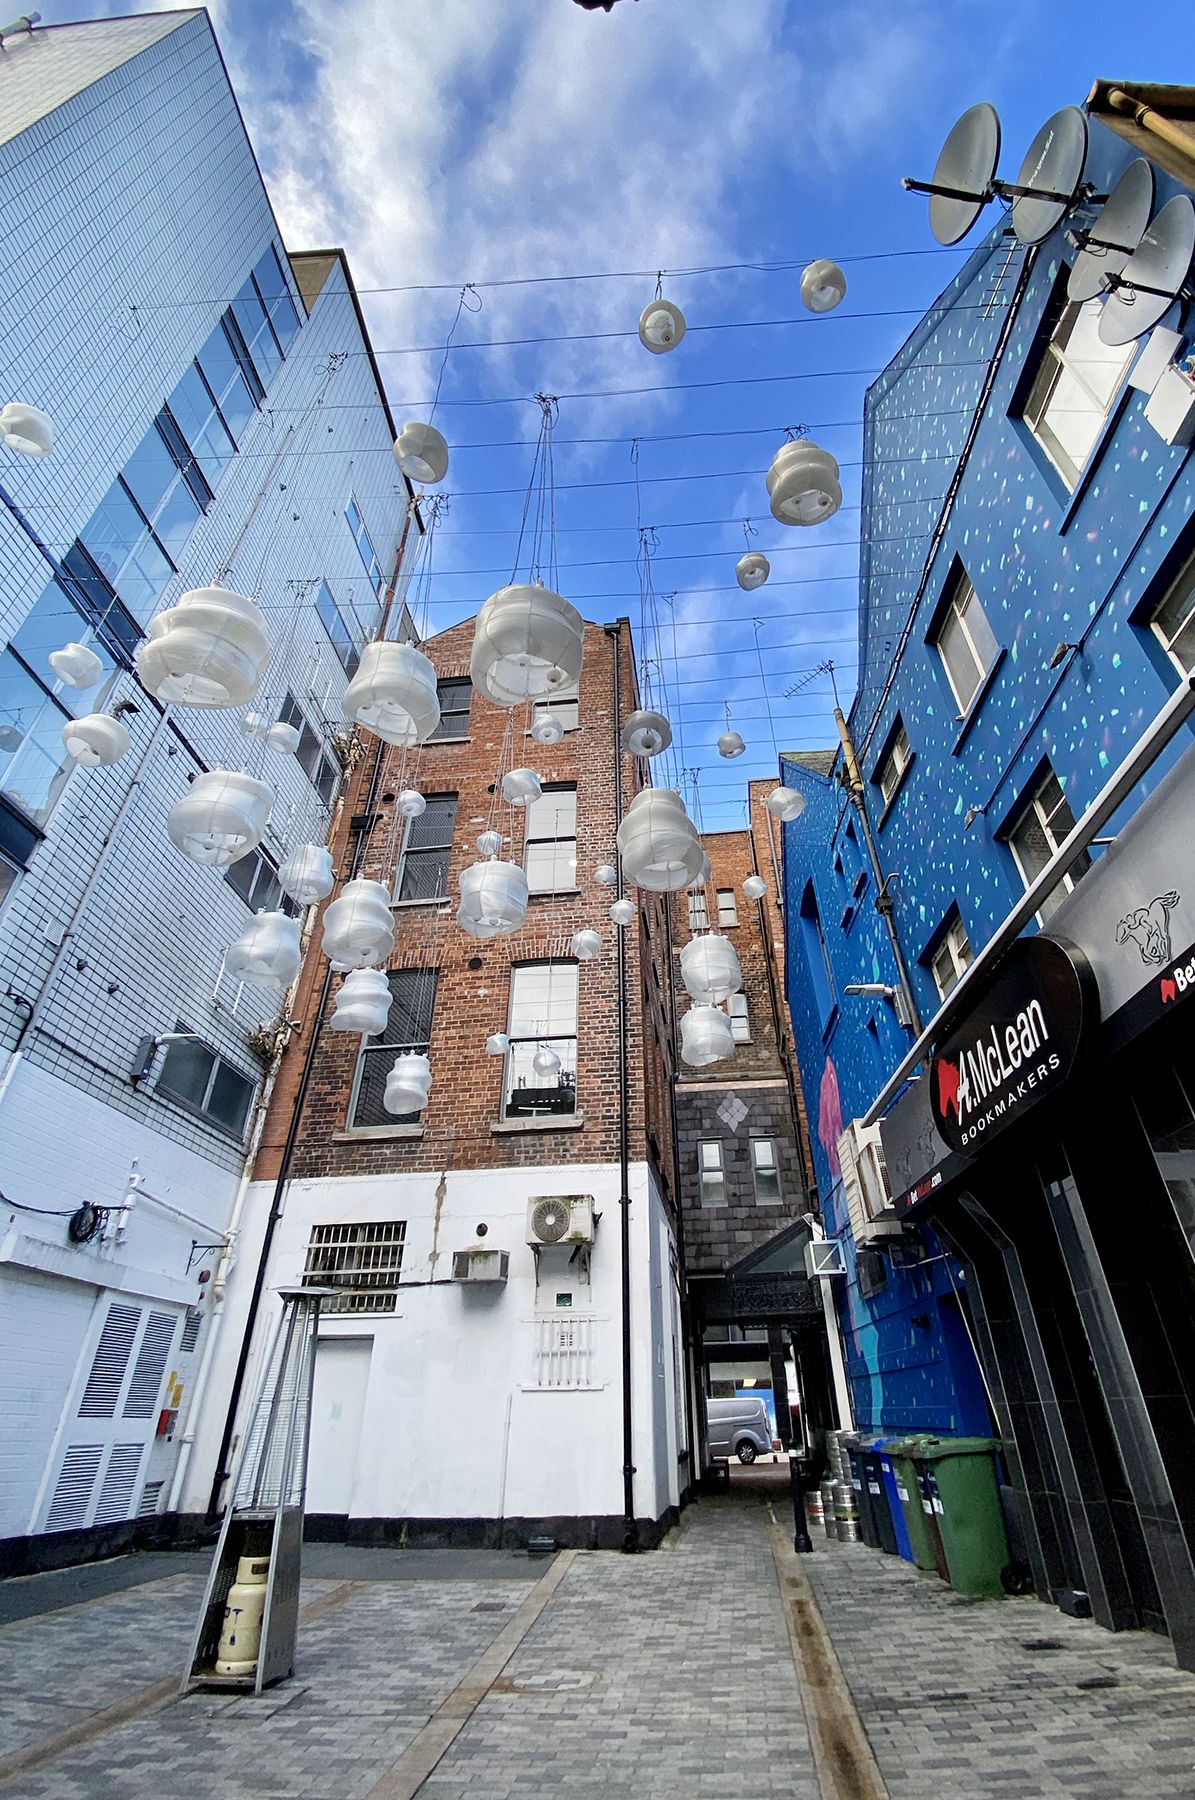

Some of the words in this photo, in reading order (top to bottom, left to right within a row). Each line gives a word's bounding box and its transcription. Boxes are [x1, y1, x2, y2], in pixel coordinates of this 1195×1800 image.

[957, 999, 1049, 1126] A.McLean
[961, 1053, 1060, 1146] BOOKMAKERS
[910, 1171, 943, 1205] BetM.com
